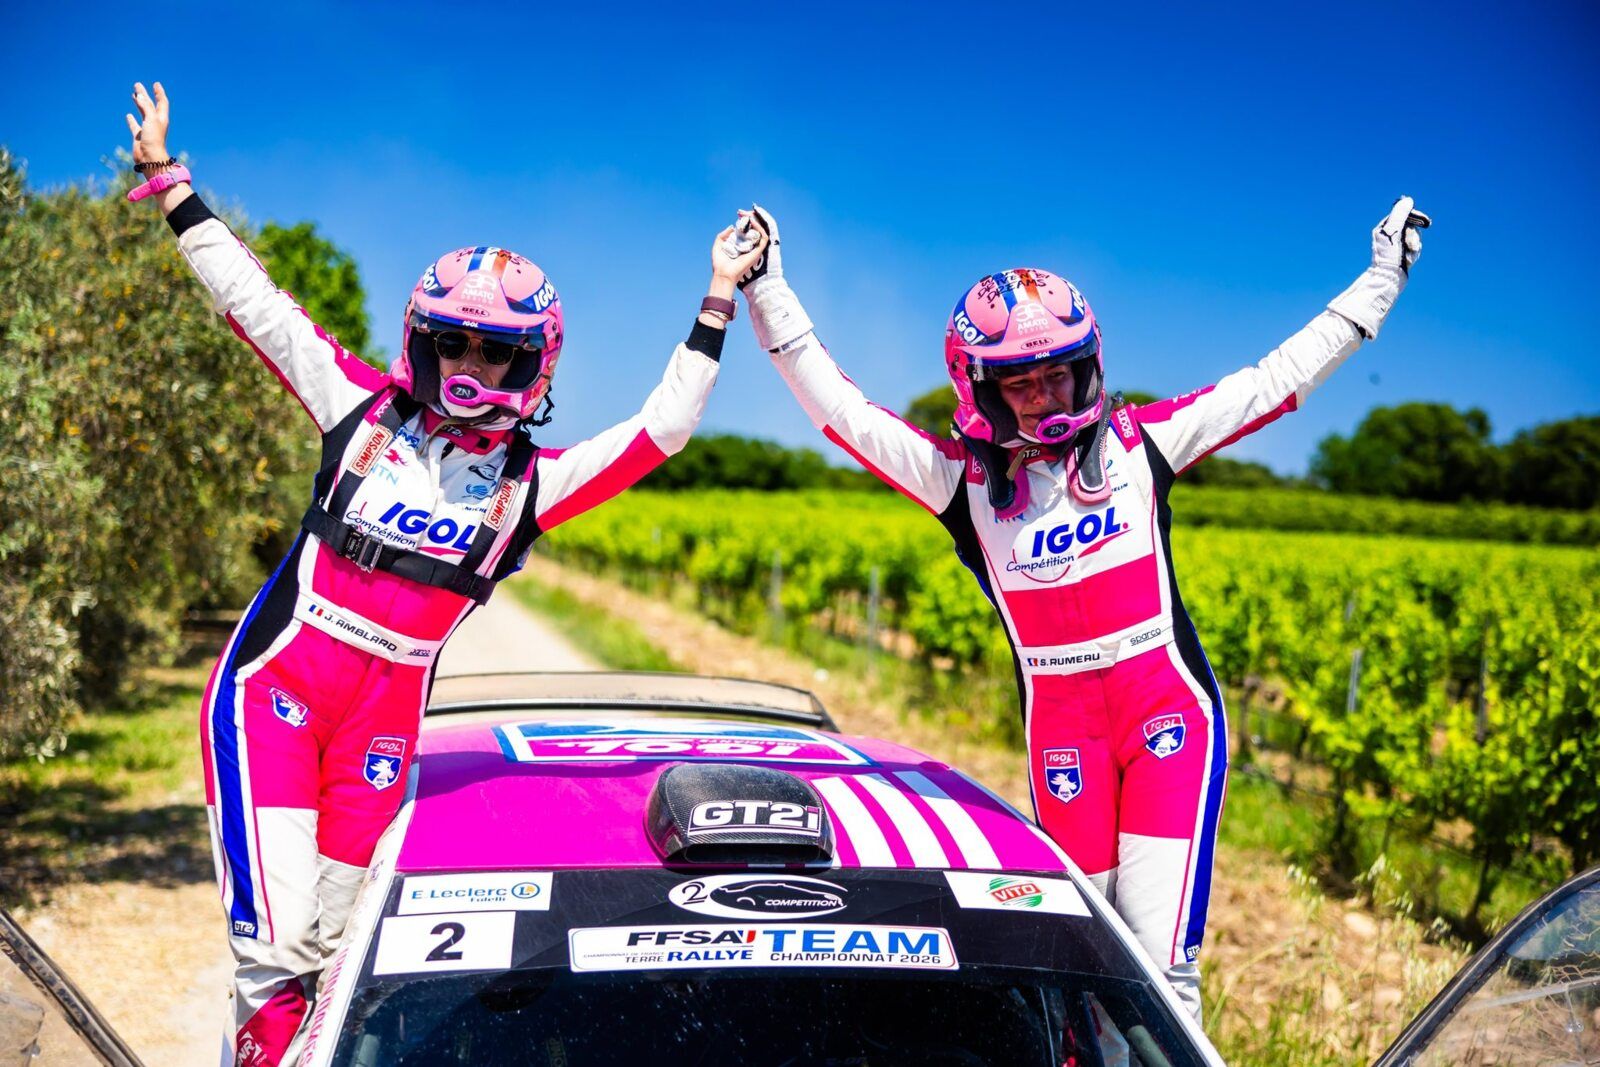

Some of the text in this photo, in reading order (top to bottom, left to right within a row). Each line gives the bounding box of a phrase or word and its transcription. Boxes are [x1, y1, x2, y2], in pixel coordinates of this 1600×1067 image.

[461, 306, 486, 316] BELL
[462, 320, 480, 328] IGOL
[1025, 338, 1049, 349] BELL
[1035, 351, 1051, 359] IGOL
[455, 386, 471, 398] ZN
[1050, 423, 1063, 434] ZN
[354, 430, 387, 473] SIMPSON
[490, 482, 514, 527] SIMPSON
[345, 510, 418, 549] Compétition
[378, 502, 477, 552] IGOL
[1005, 554, 1075, 573] Compétition
[335, 619, 398, 652] AMBLARD
[1129, 627, 1162, 646] sparco
[692, 801, 820, 830] GT2i
[430, 887, 508, 899] Leclerc
[994, 883, 1036, 901] VITO
[764, 899, 837, 908] COMPETITION
[425, 921, 466, 962] 2
[627, 930, 743, 947] FFSA
[762, 929, 939, 955] TEAM
[624, 949, 753, 963] TERRE RALLYE
[769, 952, 941, 965] CHAMPIONNAT 2026
